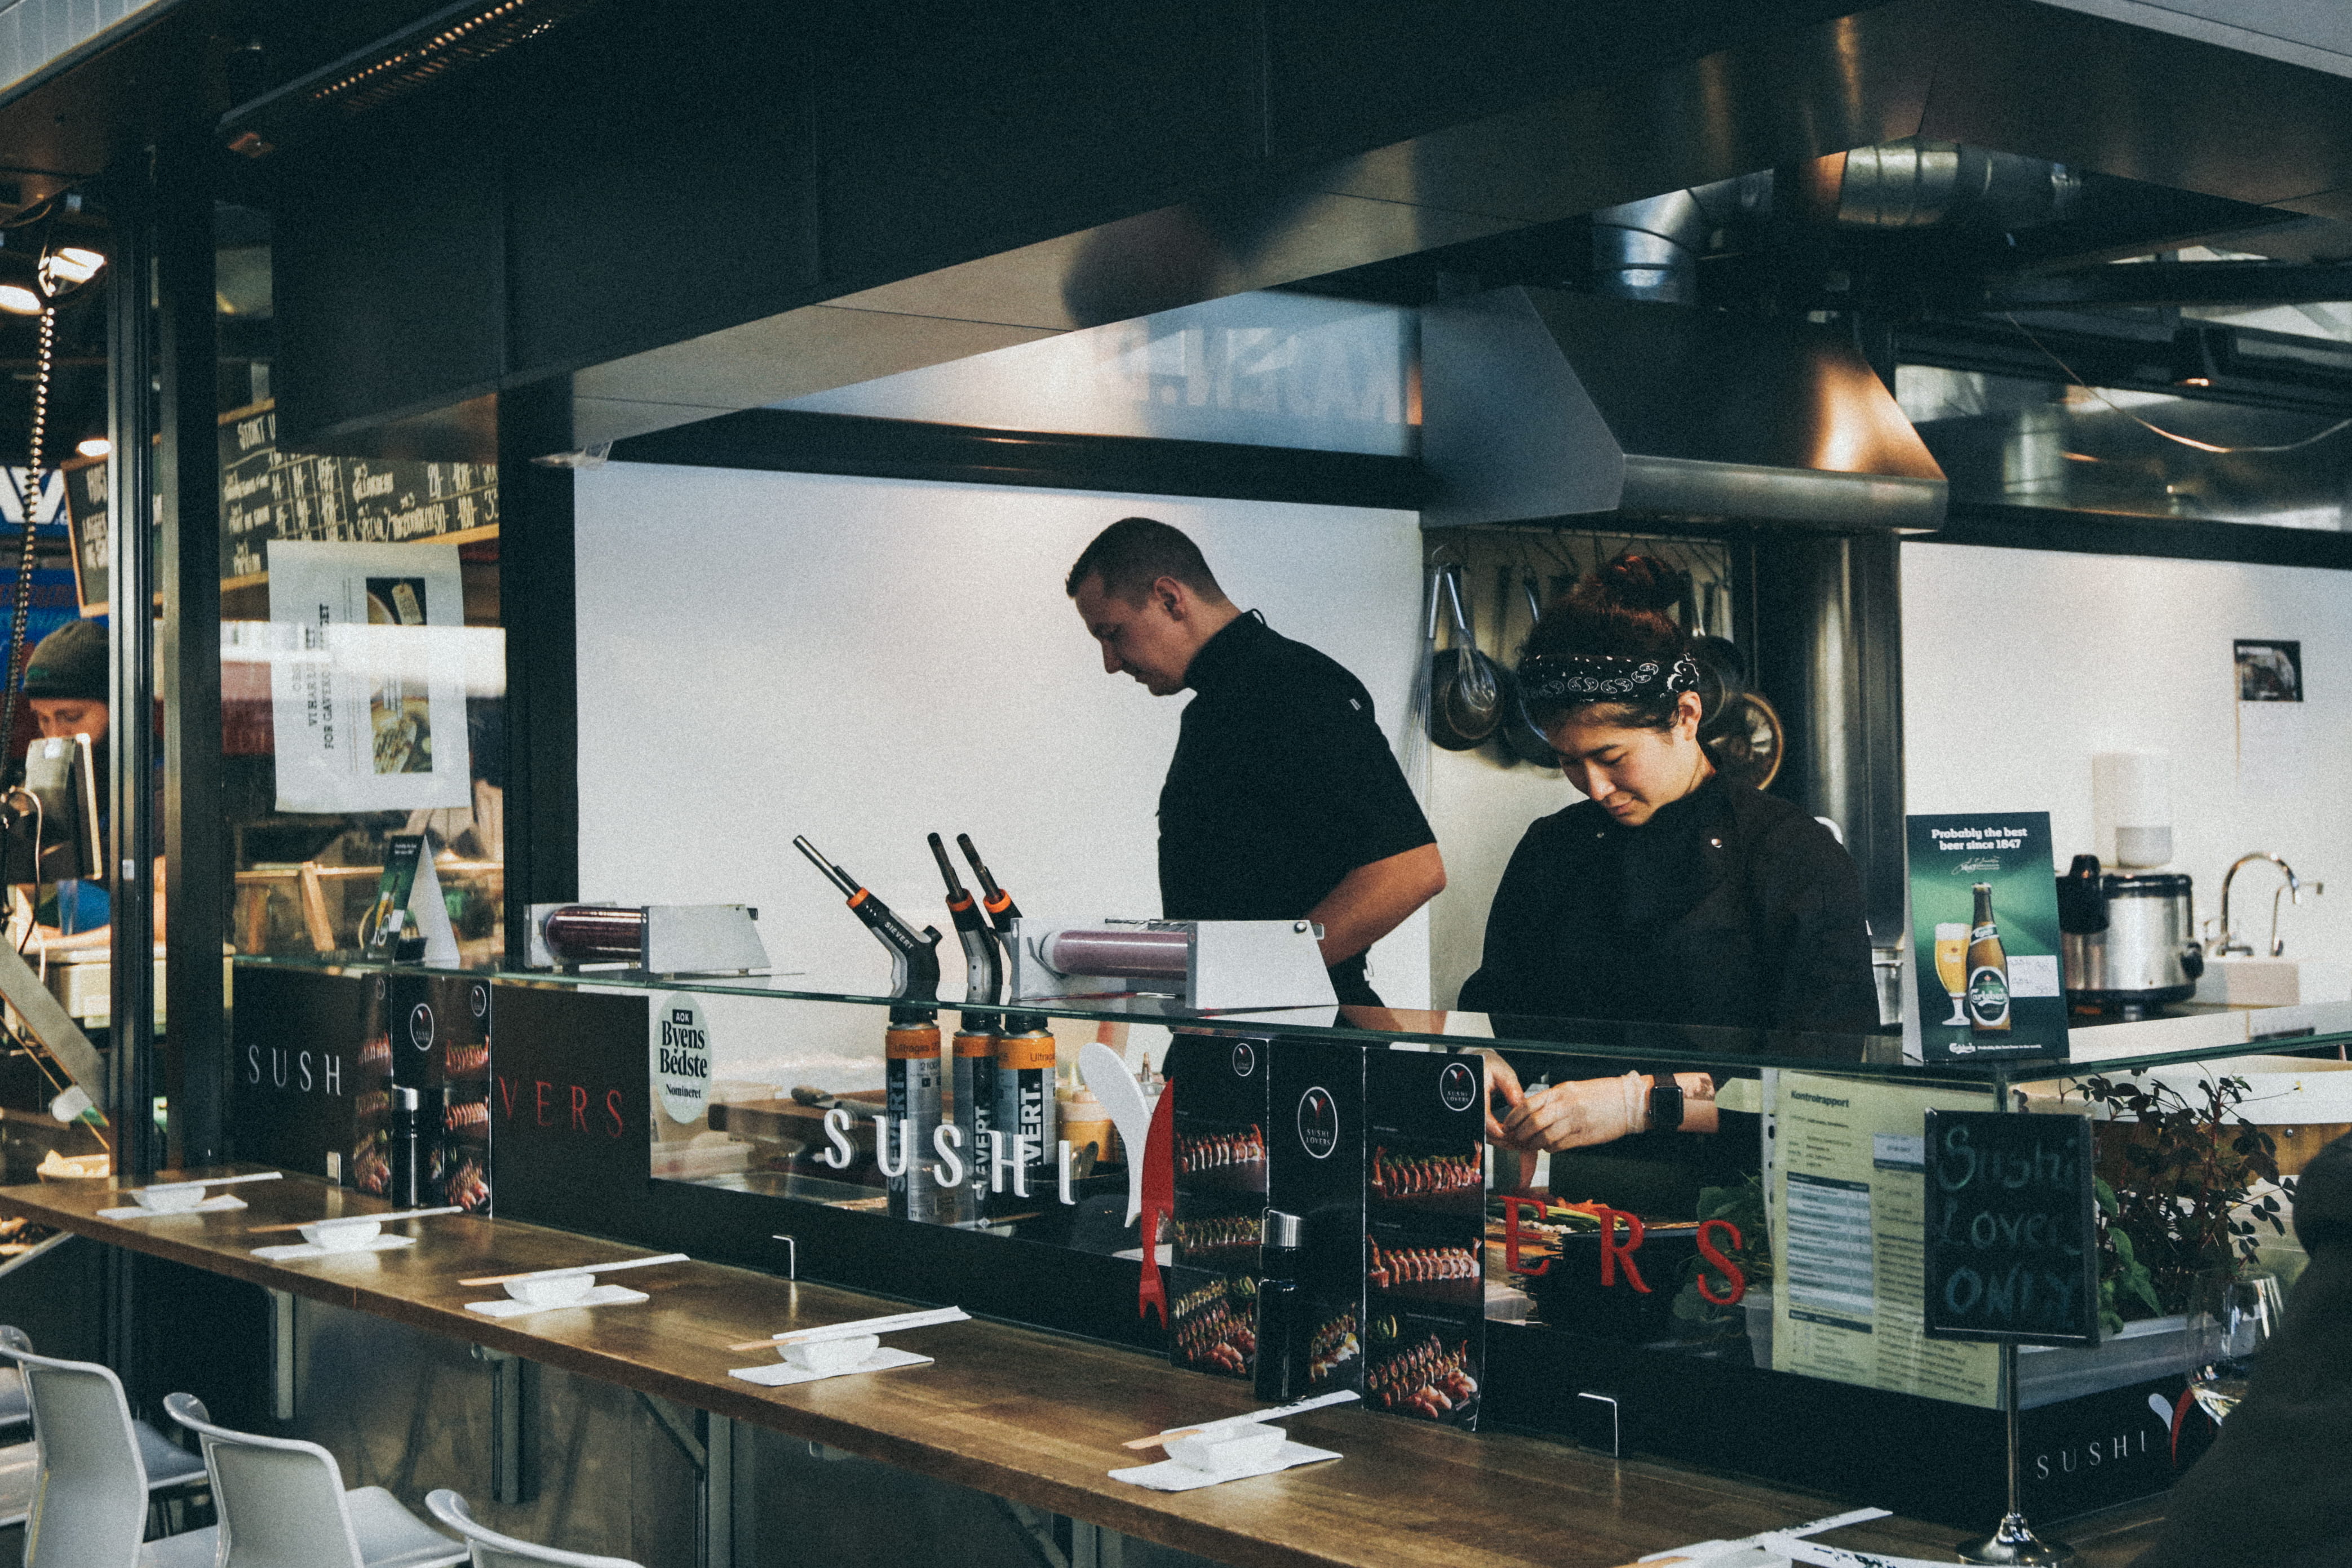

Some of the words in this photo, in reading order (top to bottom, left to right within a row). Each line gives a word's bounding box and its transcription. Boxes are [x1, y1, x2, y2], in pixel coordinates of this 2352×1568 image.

[1932, 828, 1982, 840] Probably
[1984, 827, 2002, 838] the
[2004, 827, 2028, 837] best
[1939, 840, 1964, 851] beer
[1966, 840, 1994, 850] since
[1996, 839, 2021, 849] 1847
[884, 922, 914, 950] SIEVERT
[676, 1012, 689, 1022] AOK
[662, 1020, 705, 1053] Byens
[249, 1045, 341, 1096] SUSH
[660, 1048, 707, 1078] Bedste
[666, 1083, 701, 1099] Nomineret
[1791, 1090, 1849, 1108] Kontrolrapport
[498, 1075, 623, 1137] VERS
[1305, 1137, 1330, 1146] LOVERS
[1307, 1128, 1329, 1138] SUSHI
[824, 1109, 1075, 1205] SUSHI
[1498, 1195, 1746, 1305] ERS
[2037, 1430, 2145, 1480] SUSHI
